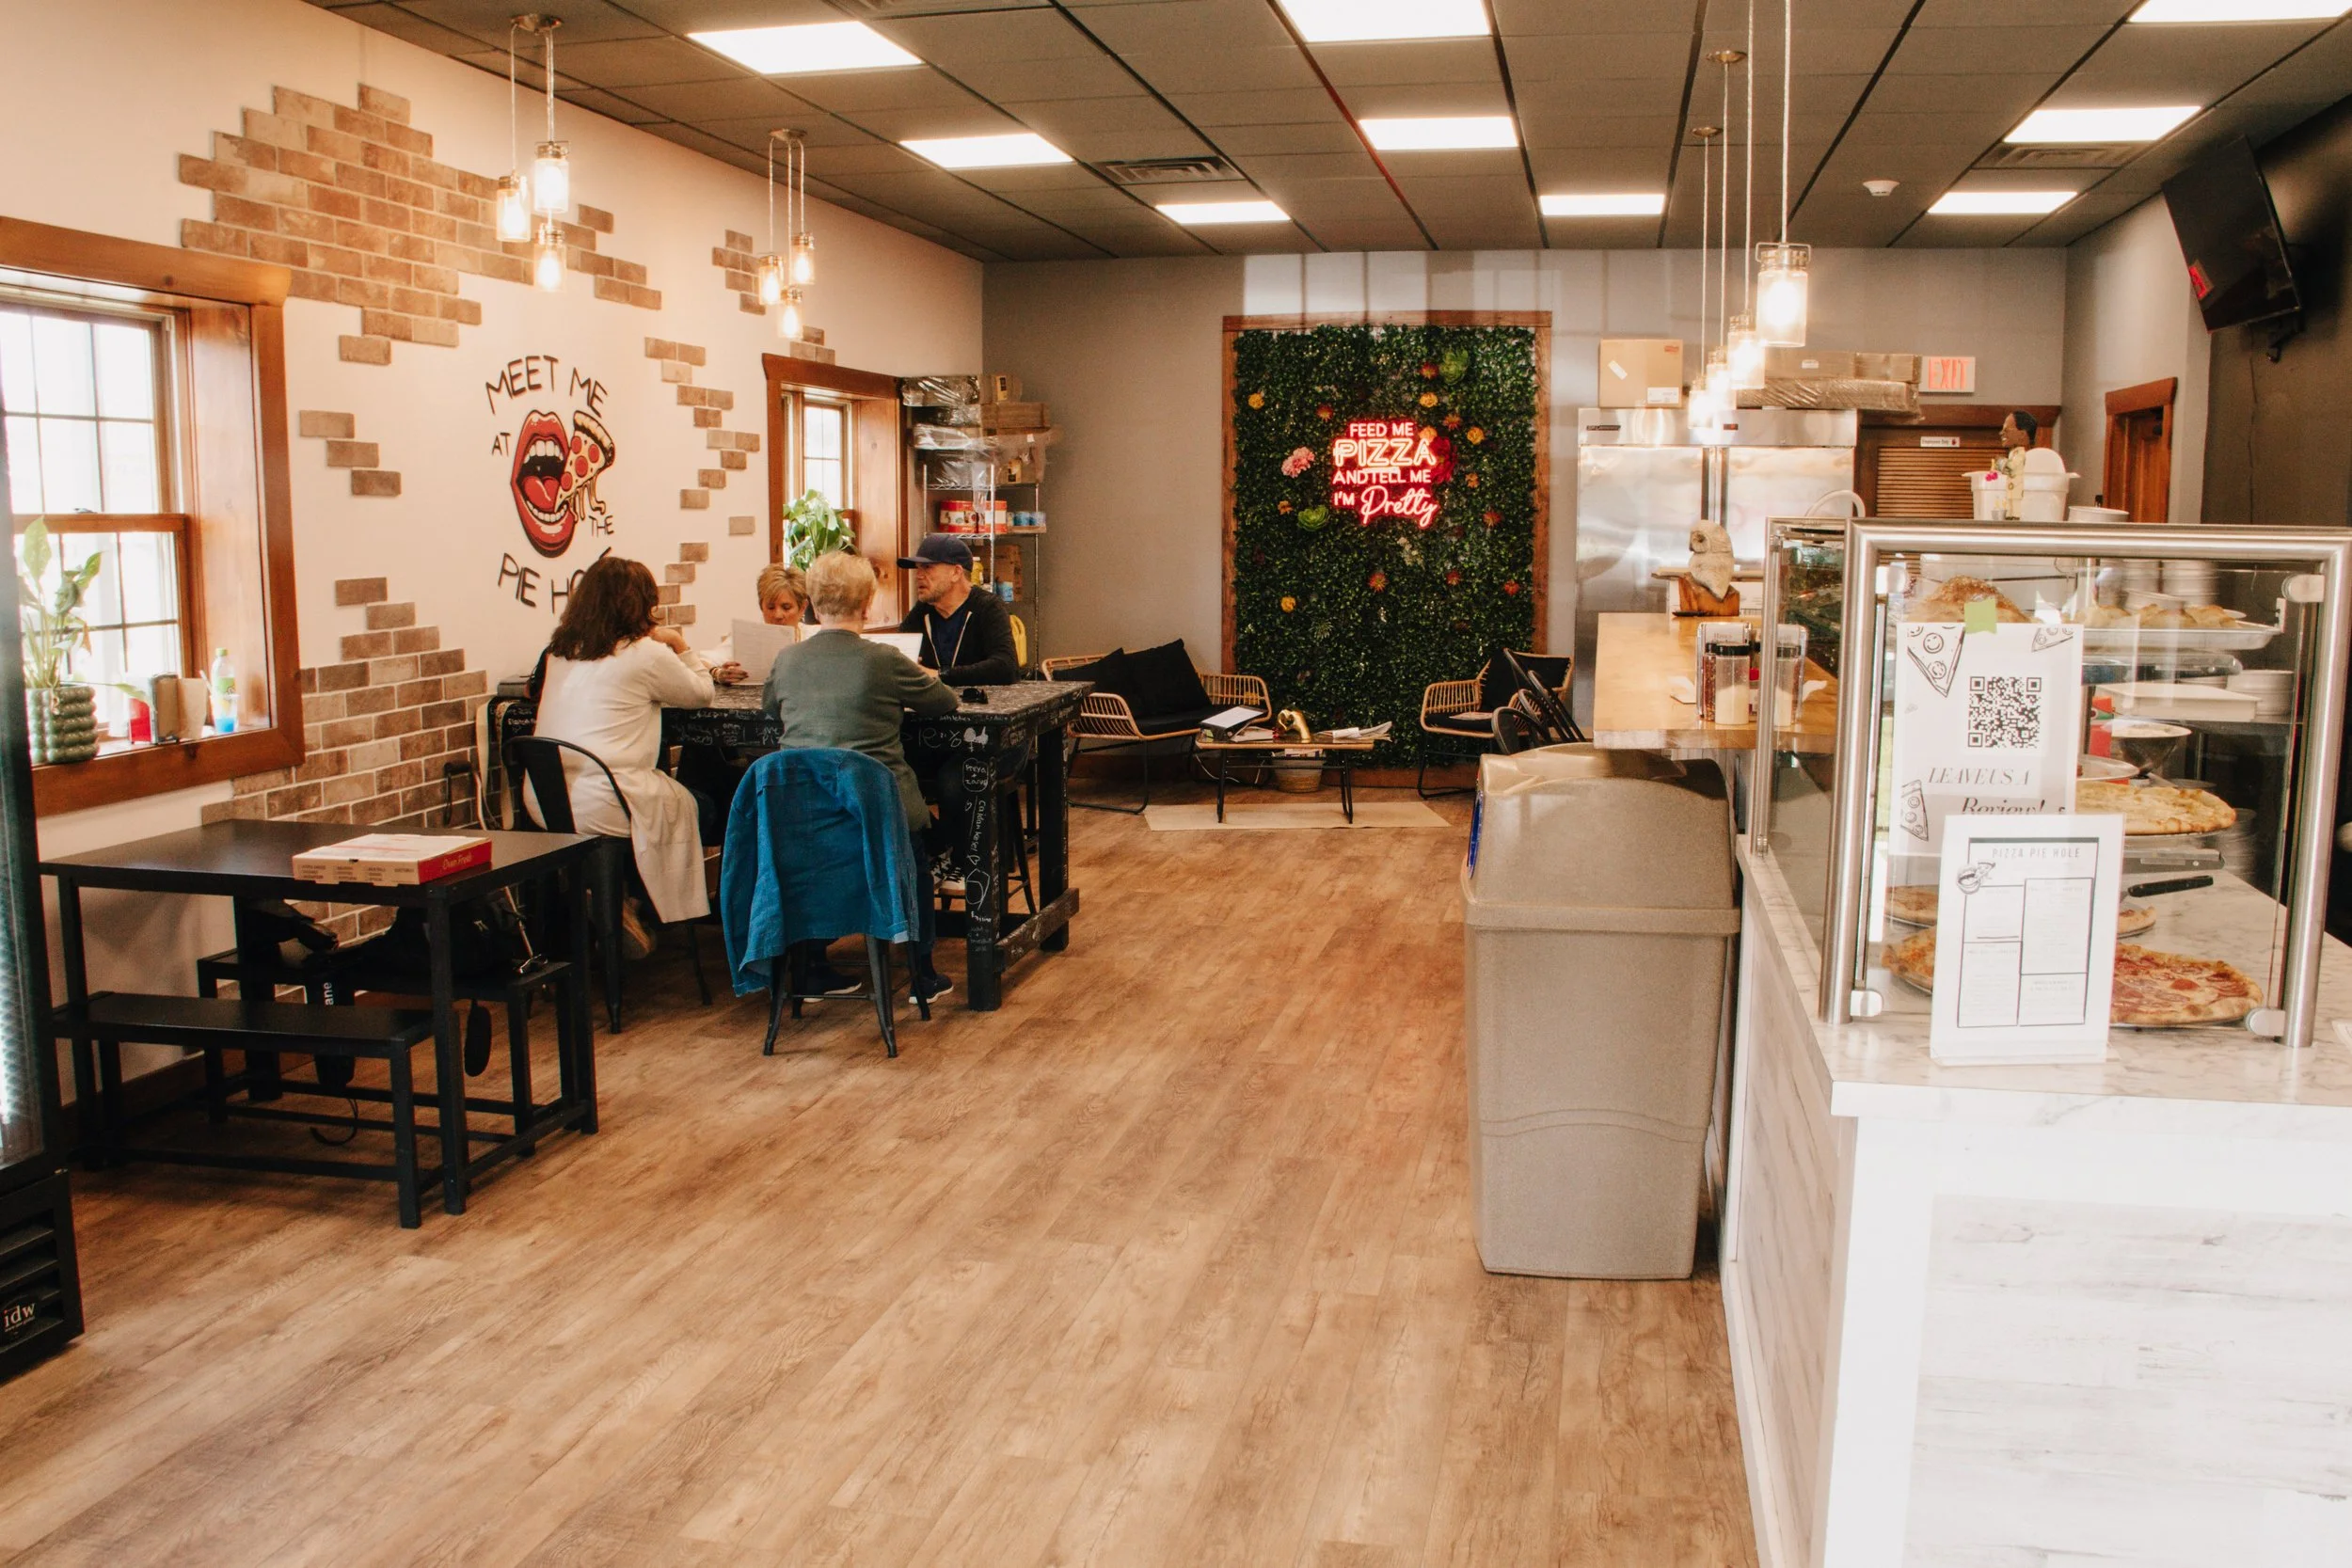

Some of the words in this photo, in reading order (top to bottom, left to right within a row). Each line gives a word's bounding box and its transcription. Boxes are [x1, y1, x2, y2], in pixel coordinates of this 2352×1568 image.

[485, 355, 559, 415] MEET
[569, 367, 608, 419] ME
[1928, 359, 1970, 390] EXIT
[1349, 422, 1388, 437] FEED
[1392, 422, 1414, 436] ME
[491, 432, 511, 456] AT
[1332, 438, 1437, 467] PIZZA
[1332, 470, 1368, 484] AND
[1369, 469, 1406, 483] TELL
[1410, 468, 1432, 483] ME
[1334, 490, 1355, 506] I'M
[1360, 484, 1438, 528] Pretty
[589, 515, 614, 538] THE
[498, 552, 541, 609] PIE
[1929, 767, 1988, 784] LEAVE
[1993, 847, 2024, 860] PIZZA
[2029, 847, 2047, 860] PIE
[2053, 847, 2081, 859] HOLE
[4, 1302, 36, 1328] idw
